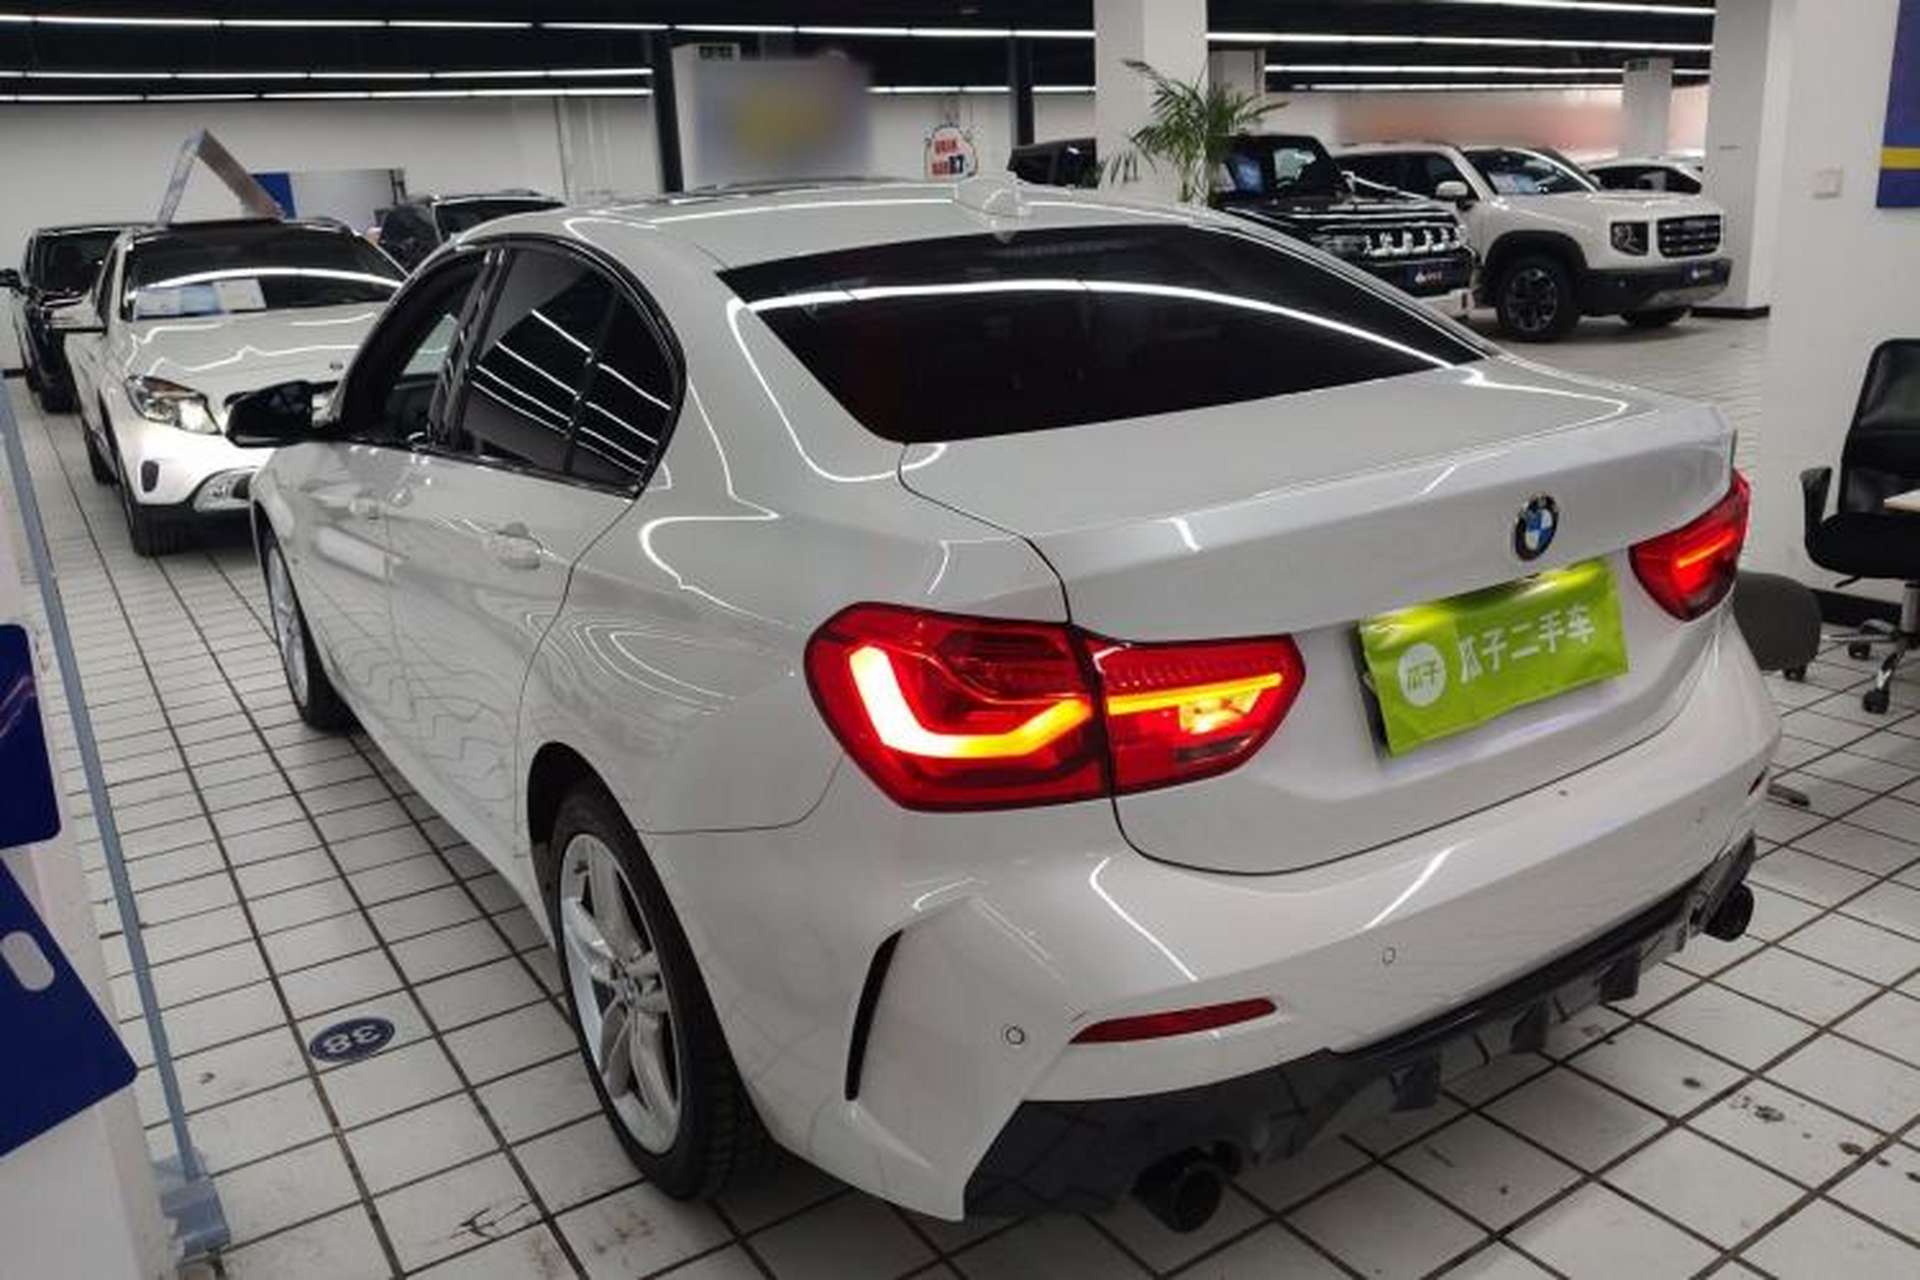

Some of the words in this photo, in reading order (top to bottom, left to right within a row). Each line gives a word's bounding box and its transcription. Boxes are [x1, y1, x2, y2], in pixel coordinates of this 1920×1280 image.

[1458, 603, 1596, 685] 瓜子二手车
